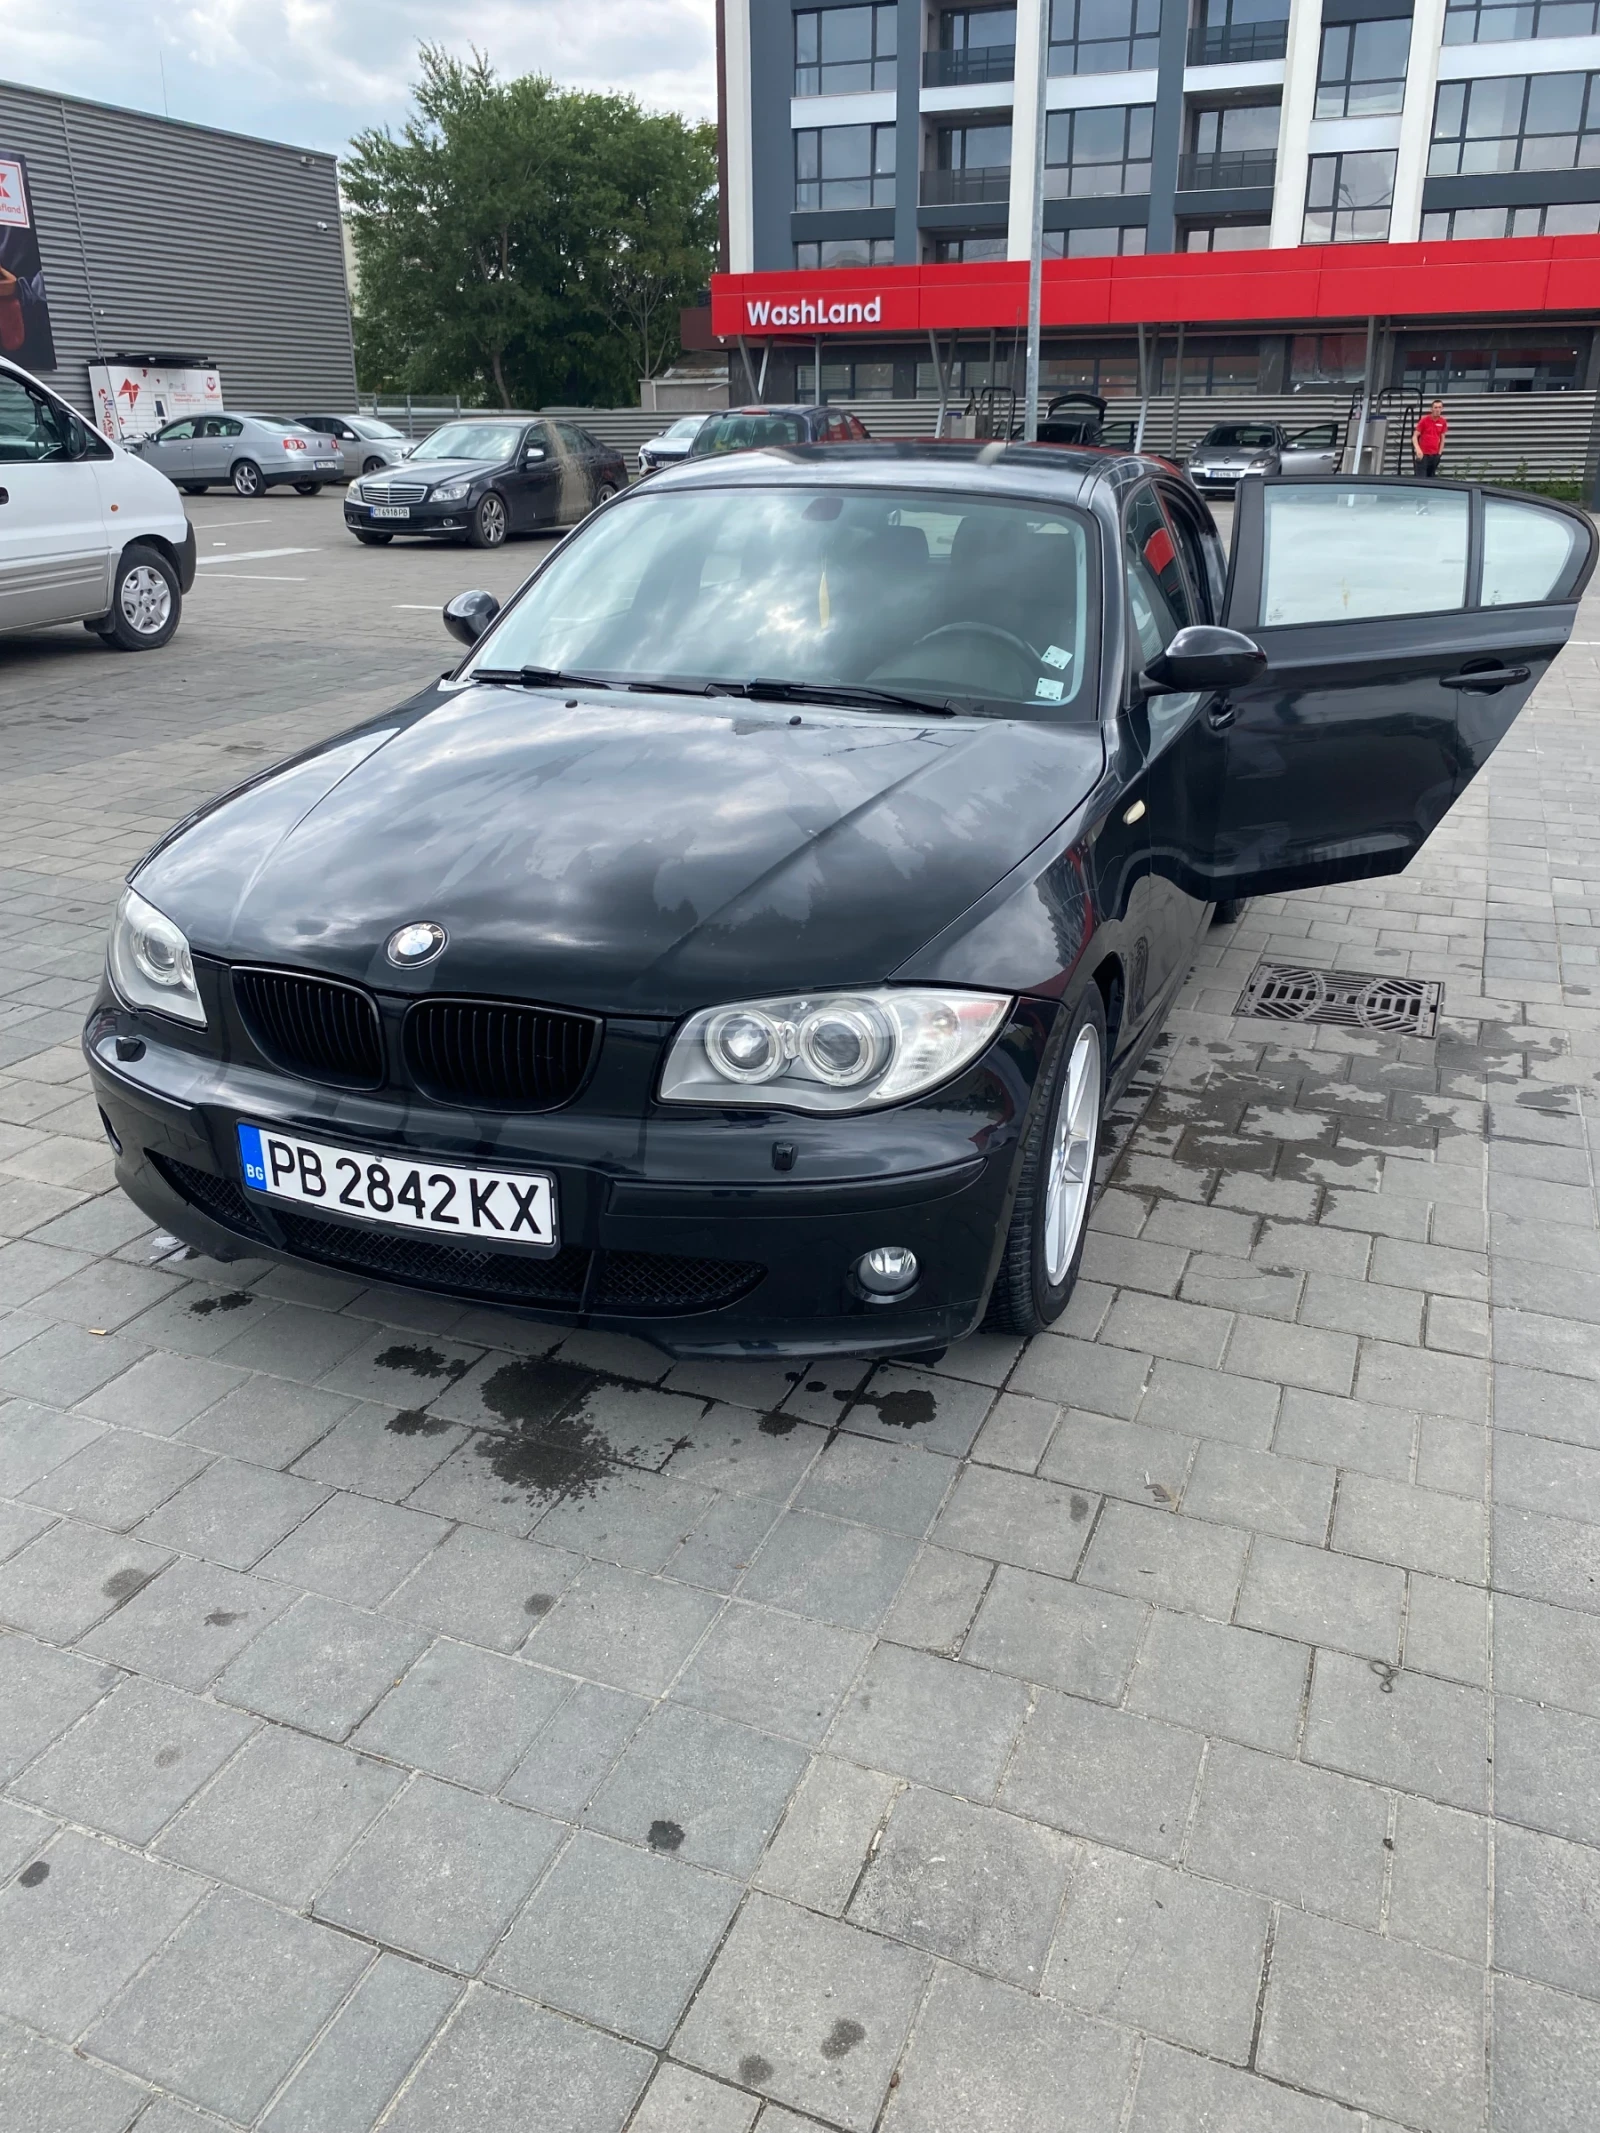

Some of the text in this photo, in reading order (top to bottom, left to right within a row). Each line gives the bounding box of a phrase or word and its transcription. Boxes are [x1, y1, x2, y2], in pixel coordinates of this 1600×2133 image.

[0, 203, 21, 214] fland
[746, 296, 881, 327] WashLand
[102, 396, 115, 440] asybox
[373, 508, 408, 517] CT 6918 PB
[246, 1162, 264, 1181] BG
[267, 1138, 542, 1235] PB 2842 KX
